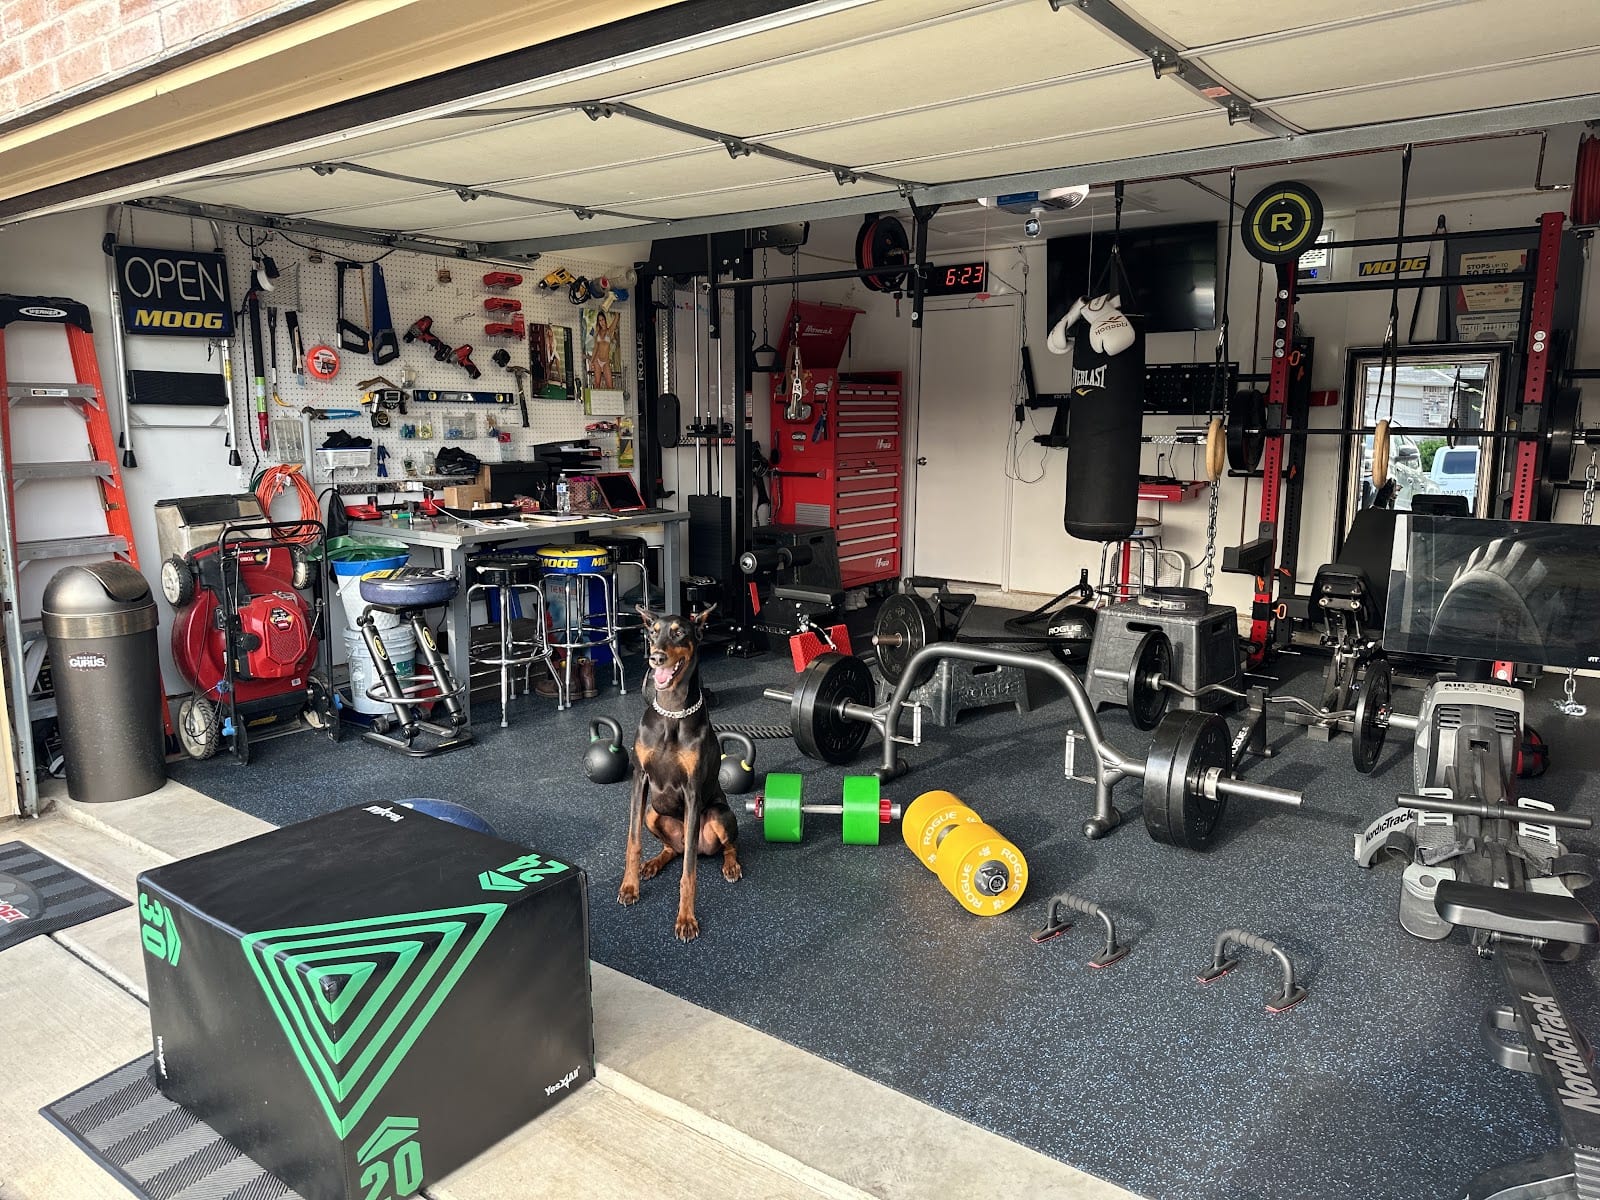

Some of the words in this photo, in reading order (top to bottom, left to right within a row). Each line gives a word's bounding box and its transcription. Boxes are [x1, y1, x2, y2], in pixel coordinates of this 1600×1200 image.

[1271, 213, 1292, 232] R
[758, 230, 768, 241] R
[125, 257, 224, 302] OPEN
[946, 266, 983, 285] 6:23
[1361, 258, 1427, 276] MOOG
[135, 309, 223, 329] MOOG
[1094, 321, 1128, 336] Reebok
[637, 332, 645, 381] ROGUE
[1072, 364, 1107, 389] VERLAST
[541, 557, 579, 569] MOOG
[592, 557, 607, 567] MO
[1048, 624, 1083, 636] ROGUE
[69, 658, 105, 668] GURUS
[923, 811, 957, 846] ROGUE
[497, 854, 570, 883] 24
[1000, 847, 1022, 893] ROGUE
[961, 863, 983, 909] ROGUE
[139, 892, 167, 960] 30
[1519, 992, 1600, 1114] NordicTrack
[360, 1141, 424, 1200] 20
